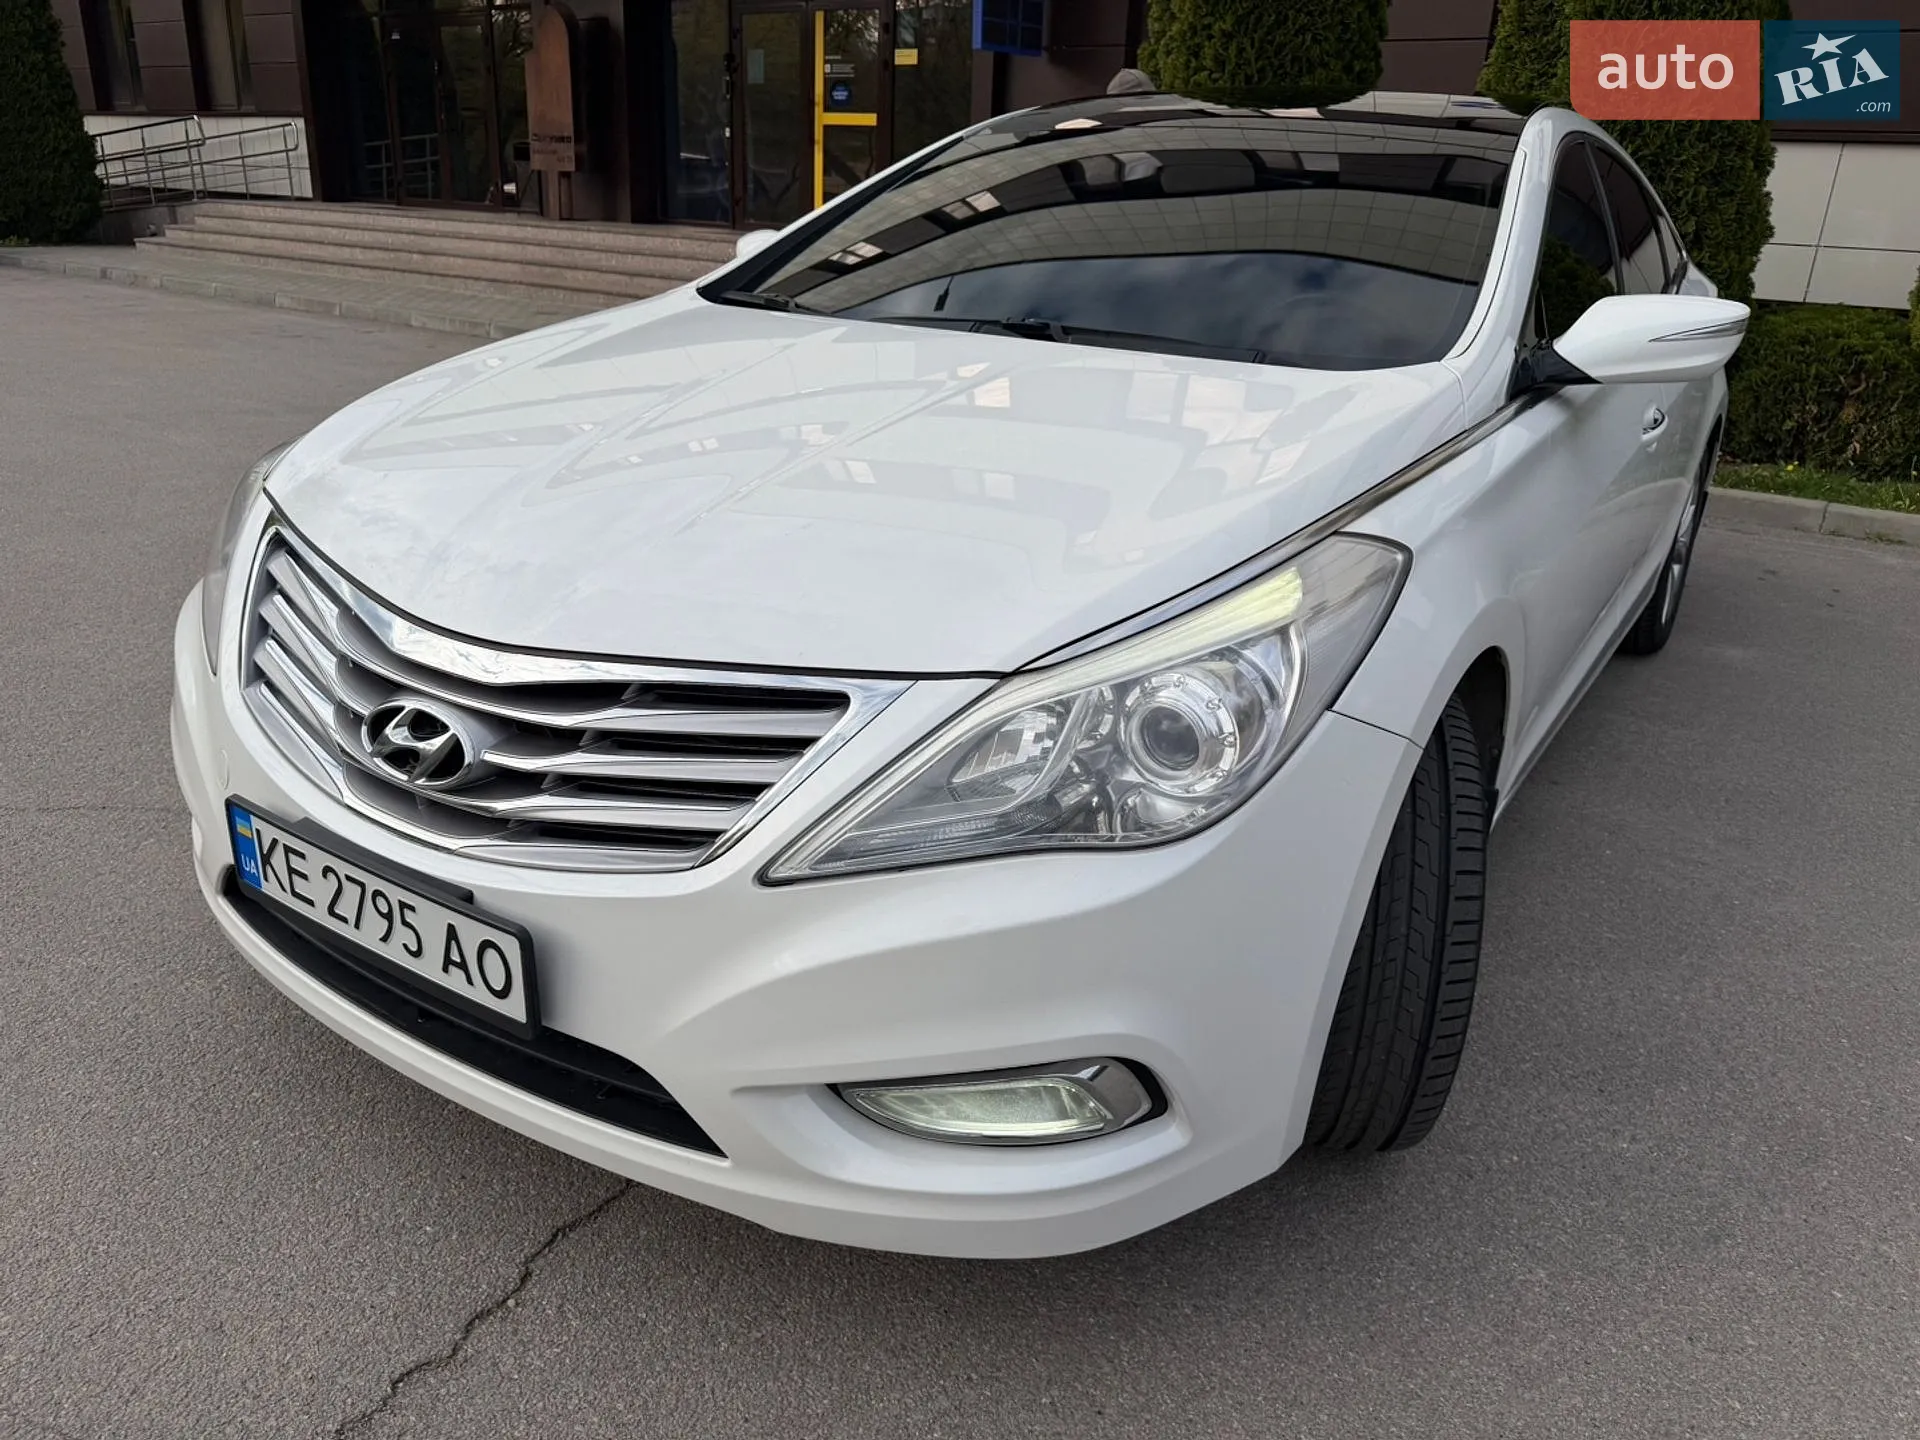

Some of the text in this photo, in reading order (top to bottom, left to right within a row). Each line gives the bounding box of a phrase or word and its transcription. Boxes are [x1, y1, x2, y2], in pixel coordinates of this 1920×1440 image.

[241, 854, 259, 877] UA
[255, 828, 512, 1000] KE 2795 AO
